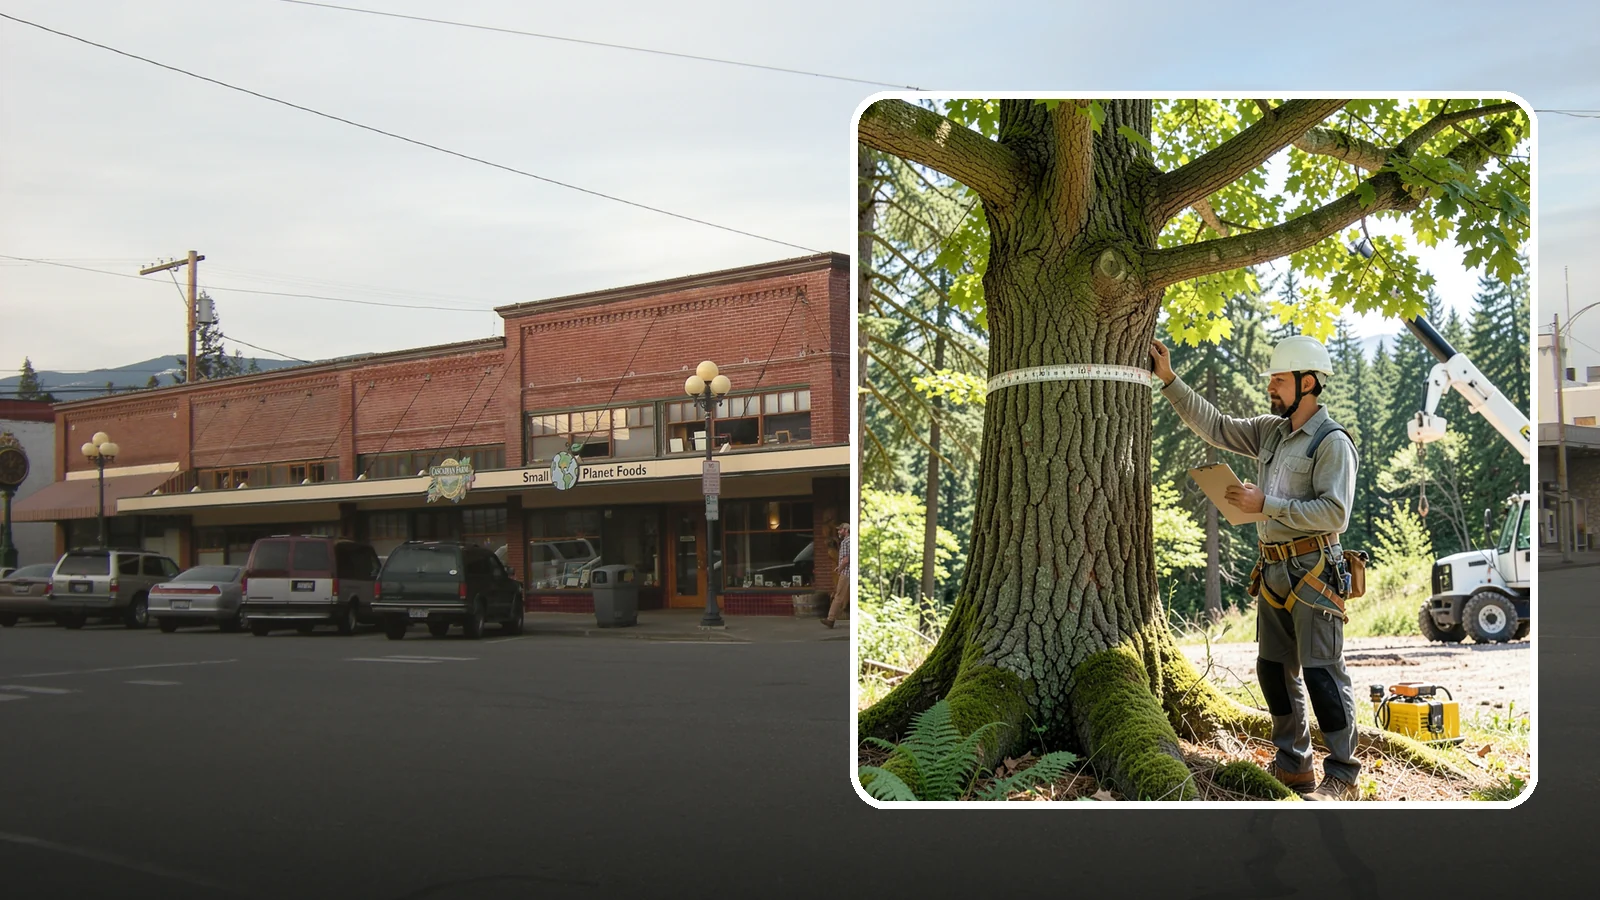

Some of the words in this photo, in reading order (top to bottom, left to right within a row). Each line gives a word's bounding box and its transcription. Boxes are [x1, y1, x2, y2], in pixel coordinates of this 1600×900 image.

[523, 470, 549, 483] Small
[583, 467, 614, 479] Planet
[617, 464, 647, 477] Foods
